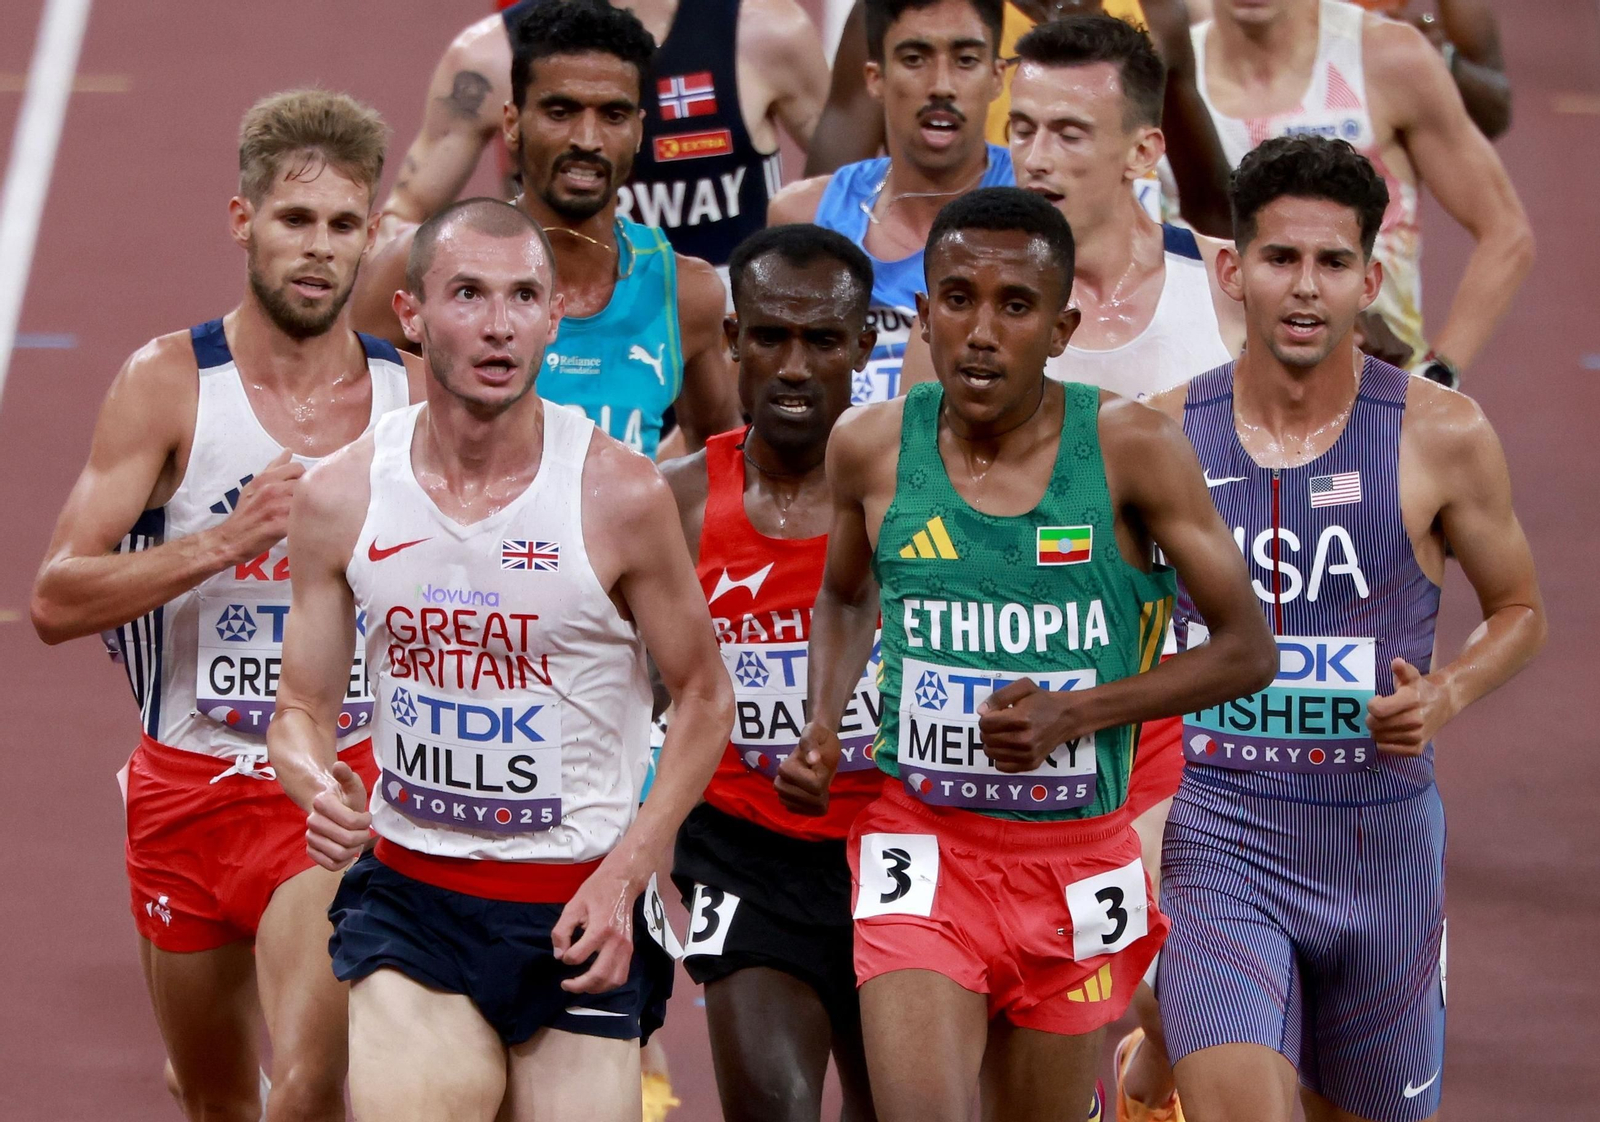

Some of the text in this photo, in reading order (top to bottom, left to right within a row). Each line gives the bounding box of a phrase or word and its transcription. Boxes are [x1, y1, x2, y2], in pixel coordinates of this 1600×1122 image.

[560, 355, 601, 367] Reliance
[414, 584, 499, 607] Novuna
[386, 606, 539, 653] GREAT
[712, 608, 814, 645] BAH
[903, 599, 1110, 654] ETHIOPIA
[388, 644, 552, 690] BRITAIN
[417, 694, 545, 744] TDK
[396, 733, 538, 794] MILLS
[880, 848, 912, 904] 3
[1094, 886, 1128, 945] 3
